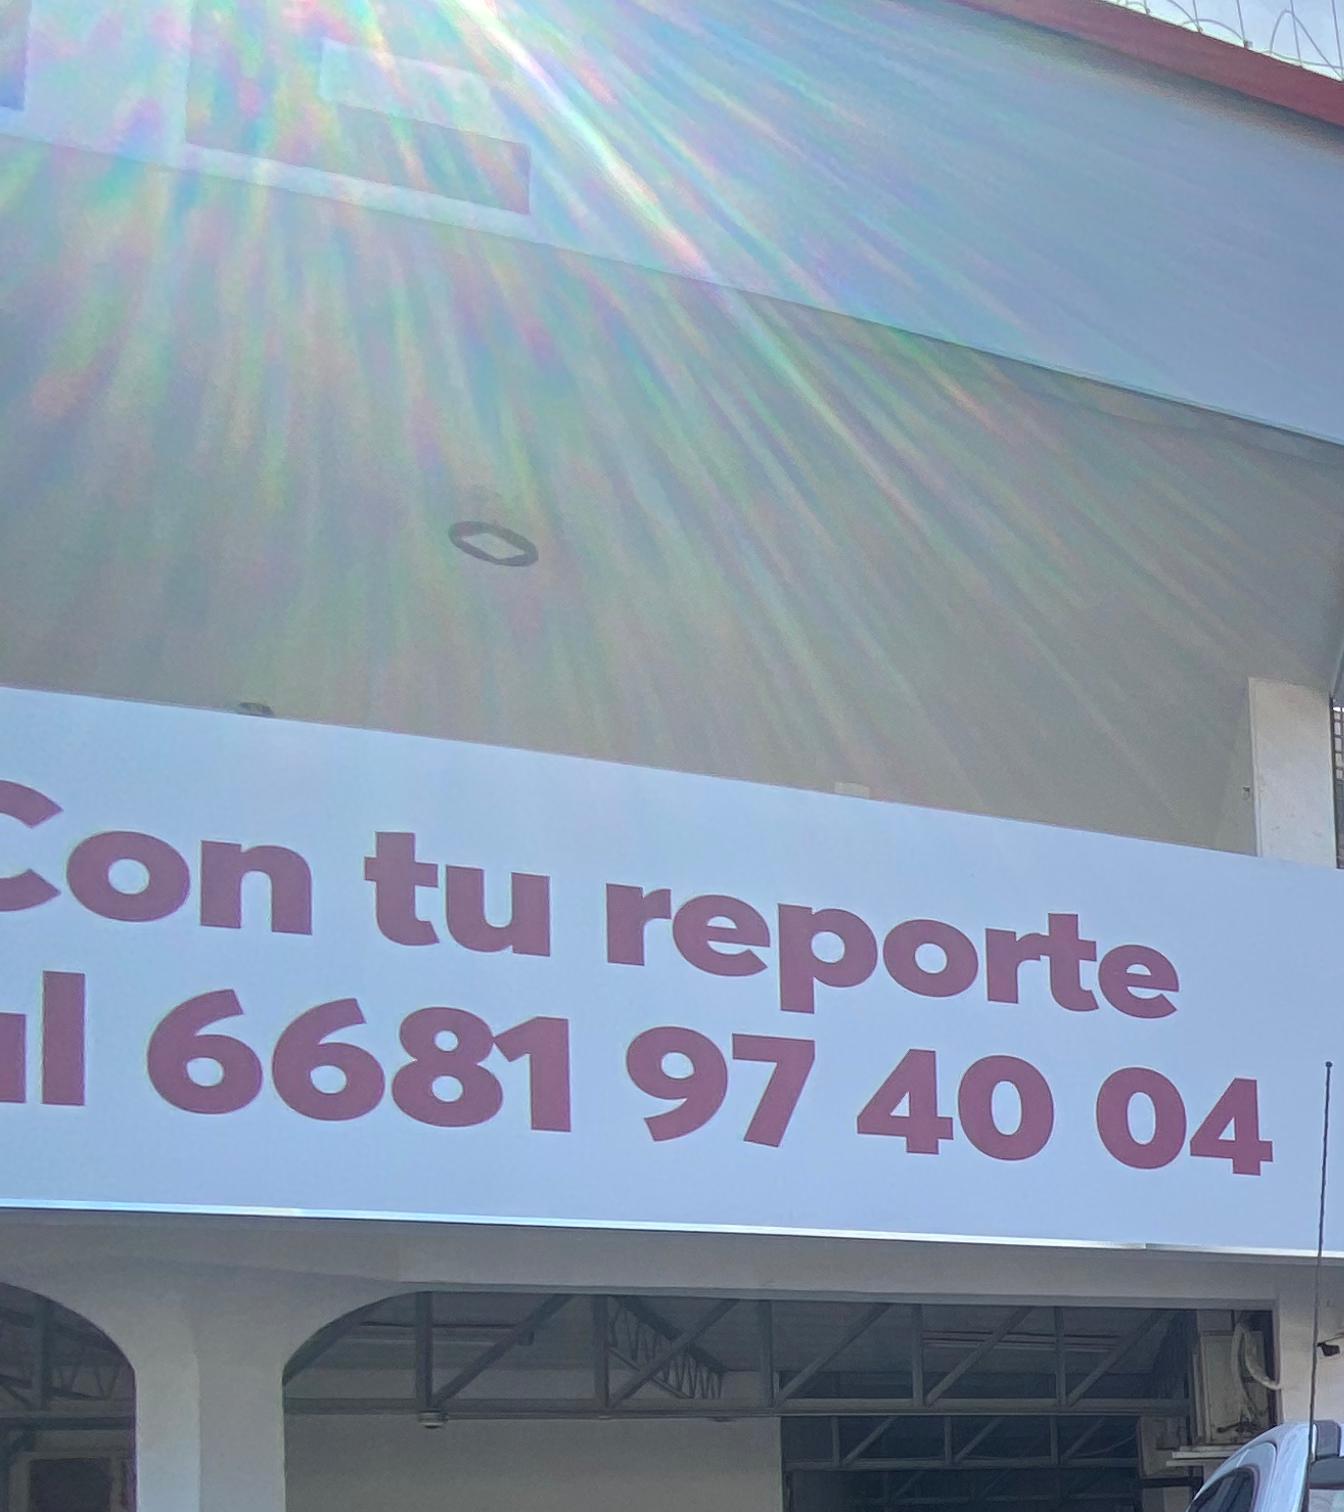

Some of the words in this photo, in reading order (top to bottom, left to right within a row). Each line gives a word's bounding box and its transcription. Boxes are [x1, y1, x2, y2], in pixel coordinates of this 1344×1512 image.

[364, 832, 550, 955] tu
[606, 885, 1180, 1020] reporte
[0, 972, 85, 1106] l
[147, 990, 572, 1132] 6681
[626, 1026, 817, 1148] 97
[856, 1049, 1054, 1162] 40
[1095, 1067, 1274, 1177] 04
